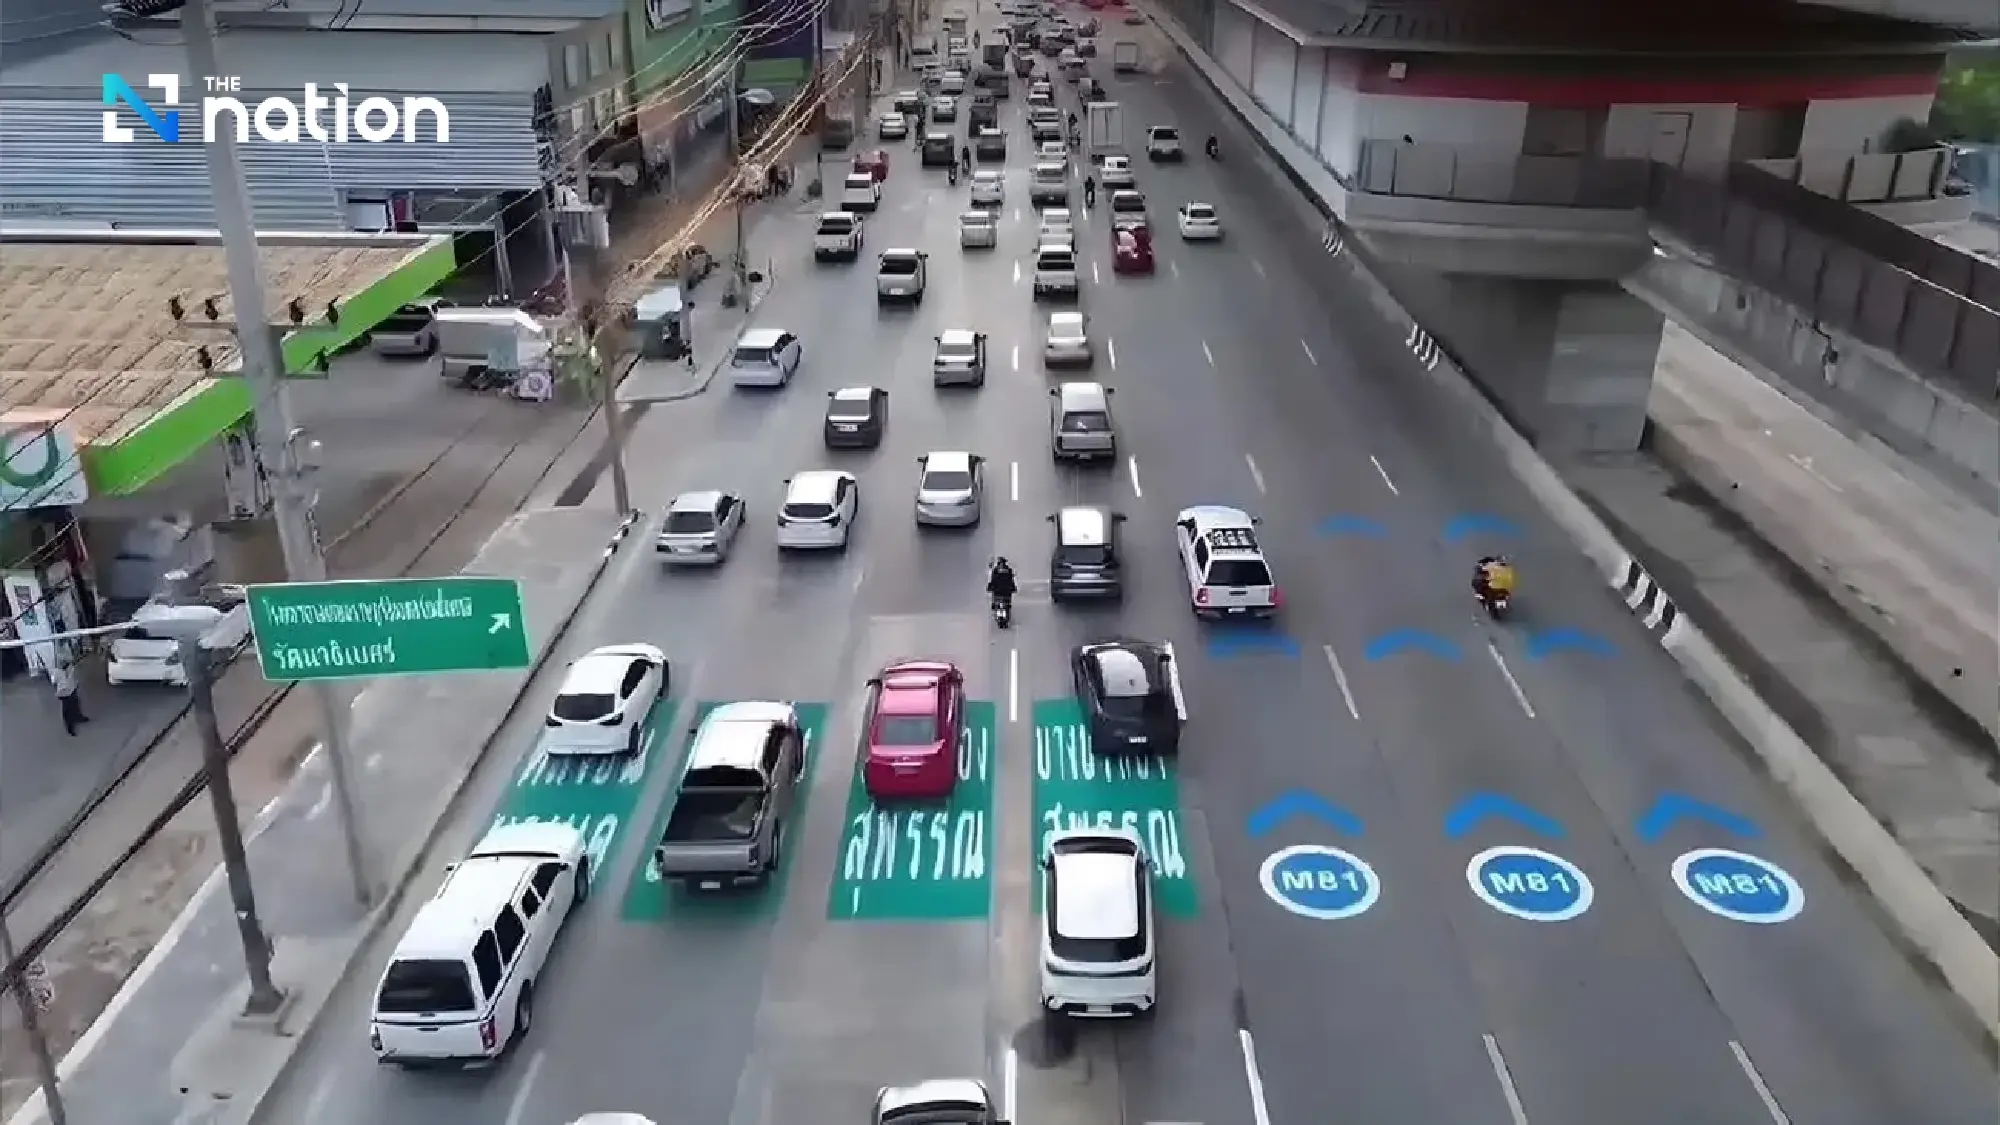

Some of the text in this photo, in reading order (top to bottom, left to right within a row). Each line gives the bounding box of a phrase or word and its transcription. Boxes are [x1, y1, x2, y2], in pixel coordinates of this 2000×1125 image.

[845, 802, 985, 915] สุพรรณ
[1280, 869, 1363, 893] M81
[1487, 869, 1573, 897] M81
[1693, 869, 1781, 897] M81
